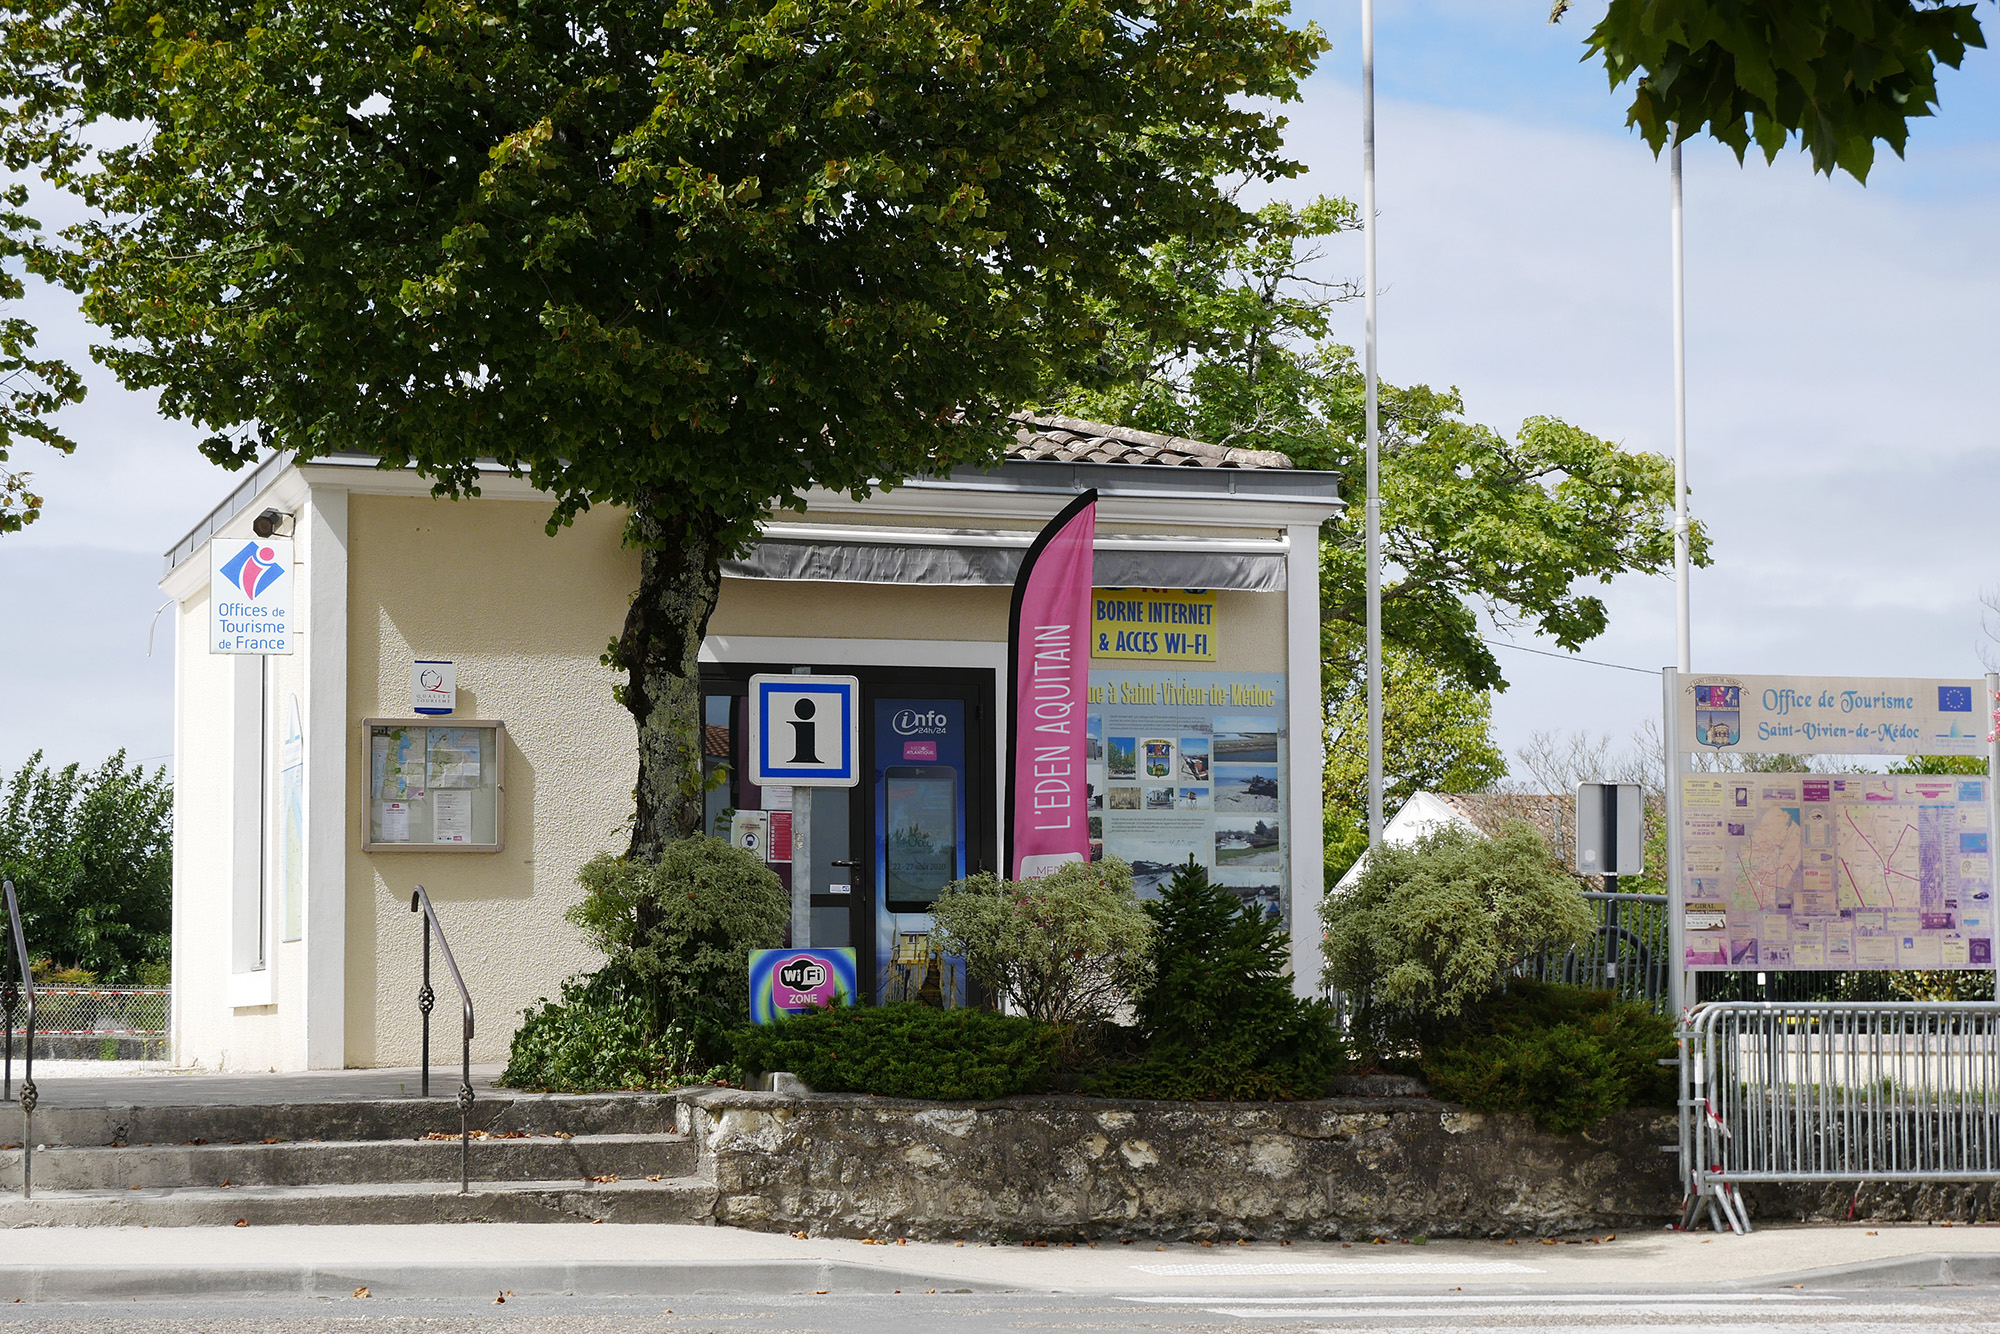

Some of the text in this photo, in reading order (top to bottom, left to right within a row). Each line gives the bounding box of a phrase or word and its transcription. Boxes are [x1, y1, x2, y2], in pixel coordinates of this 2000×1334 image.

[218, 602, 285, 617] Offices de
[1096, 600, 1213, 625] BORNE INTERNET
[219, 619, 285, 633] Tourisme
[218, 635, 285, 649] de France
[1098, 630, 1207, 655] & ACCES WI-FI
[1034, 624, 1075, 734] AQUITAIN
[1108, 681, 1118, 705] à
[1121, 681, 1276, 708] Saint-Vivien-de-Médoc
[1762, 688, 1914, 715] Office de Tourisme
[1757, 721, 1920, 743] Saint-Vivien-de-Médoc
[1034, 745, 1071, 830] L'EDEN
[789, 994, 818, 1004] ZONE
